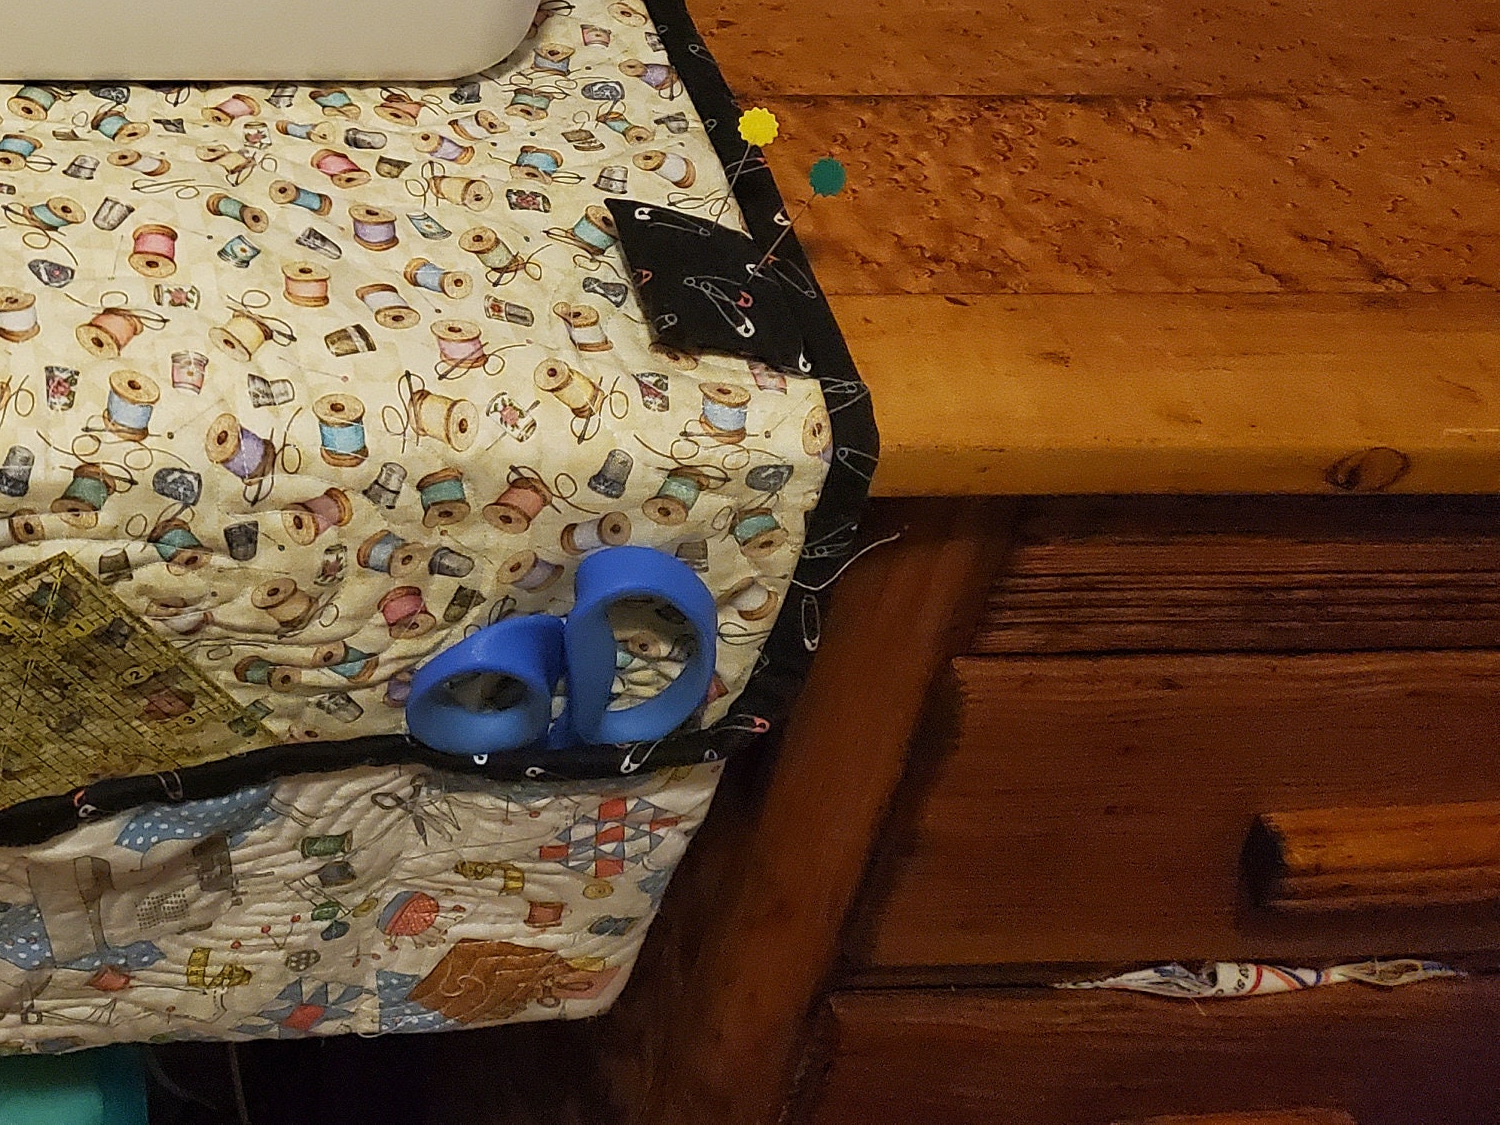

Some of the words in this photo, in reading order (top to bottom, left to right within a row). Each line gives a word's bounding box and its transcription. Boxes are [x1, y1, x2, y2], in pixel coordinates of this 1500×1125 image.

[1, 619, 14, 629] 1
[73, 623, 86, 633] 1
[129, 670, 141, 681] 2
[184, 715, 197, 726] 3
